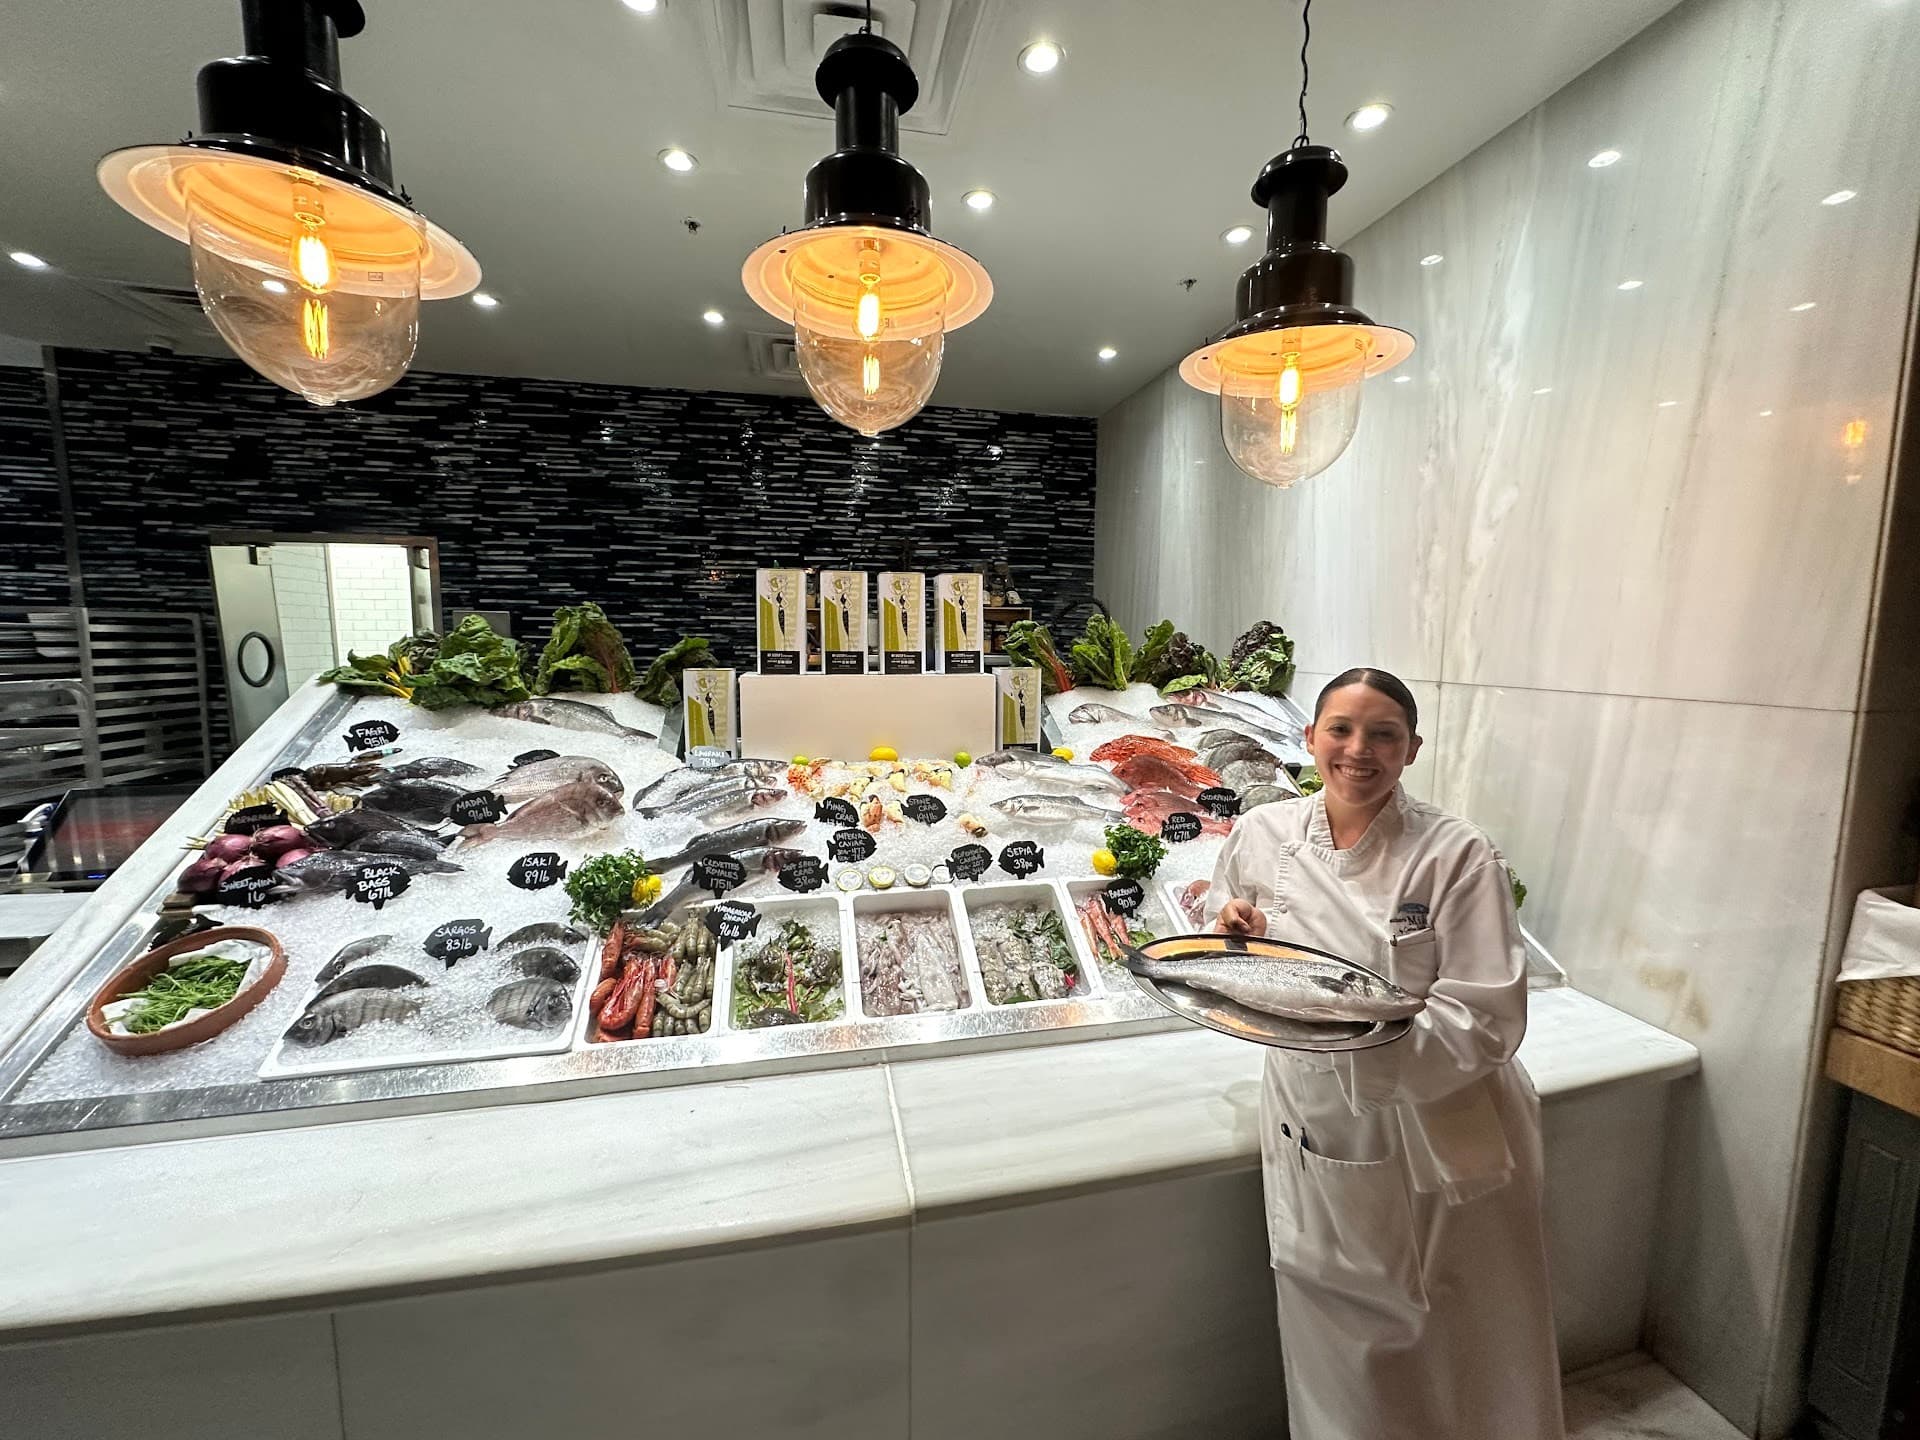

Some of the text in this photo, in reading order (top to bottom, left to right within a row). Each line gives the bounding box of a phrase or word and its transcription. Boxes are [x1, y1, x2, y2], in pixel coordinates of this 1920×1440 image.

[456, 796, 488, 812] MADAI
[826, 800, 847, 814] KING
[918, 803, 939, 811] CRAB
[468, 806, 493, 821] 96lb
[835, 812, 855, 823] CRAB
[1164, 822, 1198, 831] SNAPPER
[835, 832, 868, 840] IMPERIAL
[838, 840, 866, 848] CAVIAR
[1006, 846, 1034, 857] SEPIA
[521, 856, 553, 867] ISAKI
[362, 866, 401, 879] BLACK
[524, 869, 550, 884] 89lb
[705, 866, 739, 880] ROYALES
[793, 867, 815, 877] CRAB
[219, 876, 277, 892] SWEET ONION
[356, 876, 391, 892] BASS
[247, 890, 266, 904] 16
[367, 886, 394, 900] 67lb
[722, 912, 749, 924] SHRIMP
[434, 925, 477, 938] SARGOS
[719, 921, 740, 938] 96lb
[446, 938, 473, 951] 83lb
